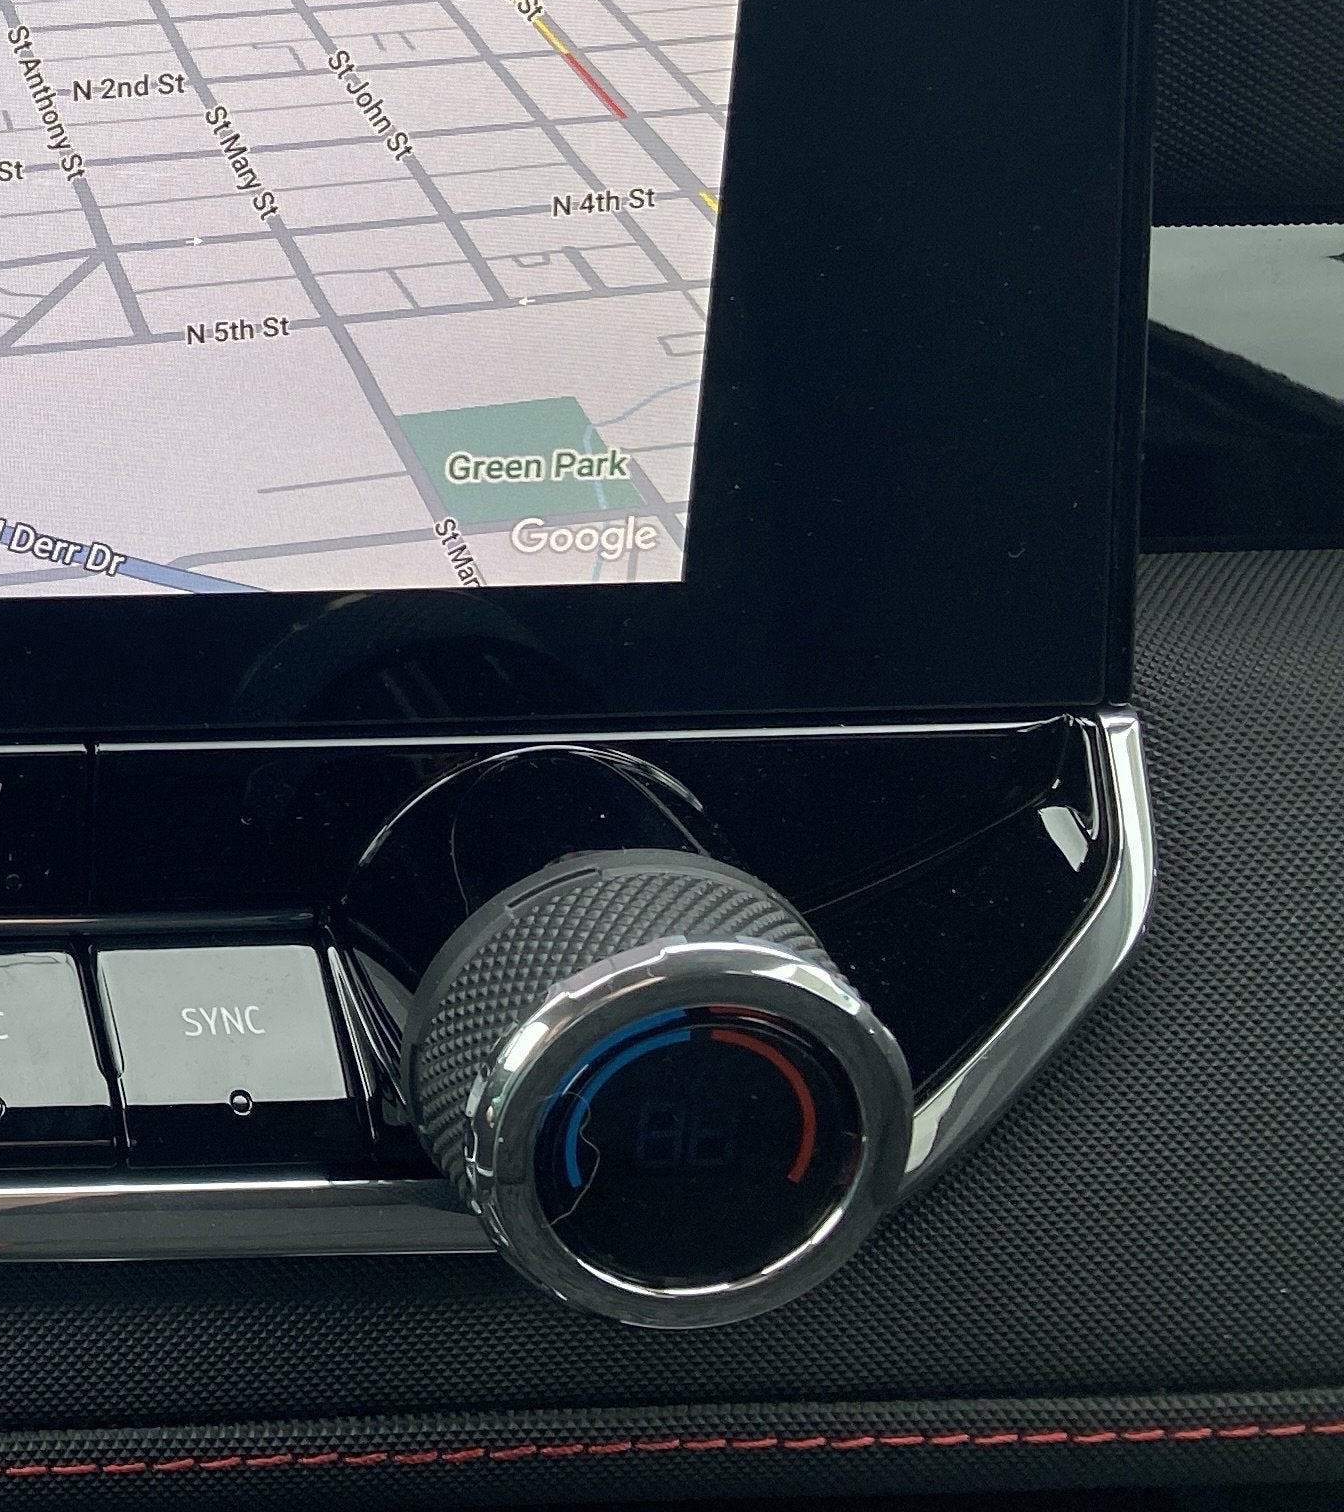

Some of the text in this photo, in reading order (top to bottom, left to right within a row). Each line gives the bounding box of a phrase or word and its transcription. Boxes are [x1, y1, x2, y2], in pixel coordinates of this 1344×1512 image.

[73, 73, 185, 100] N 2nd St
[8, 25, 85, 183] St Anthony St
[329, 50, 413, 163] St John St
[205, 105, 279, 222] St Mary St
[552, 188, 655, 217] N 4th St
[186, 317, 290, 345] N 5th St
[449, 450, 627, 481] Green Park
[435, 519, 459, 545] St
[511, 515, 658, 561] Google
[8, 524, 81, 564] Derr
[84, 545, 127, 578] Dr
[180, 1005, 266, 1037] SYNC
